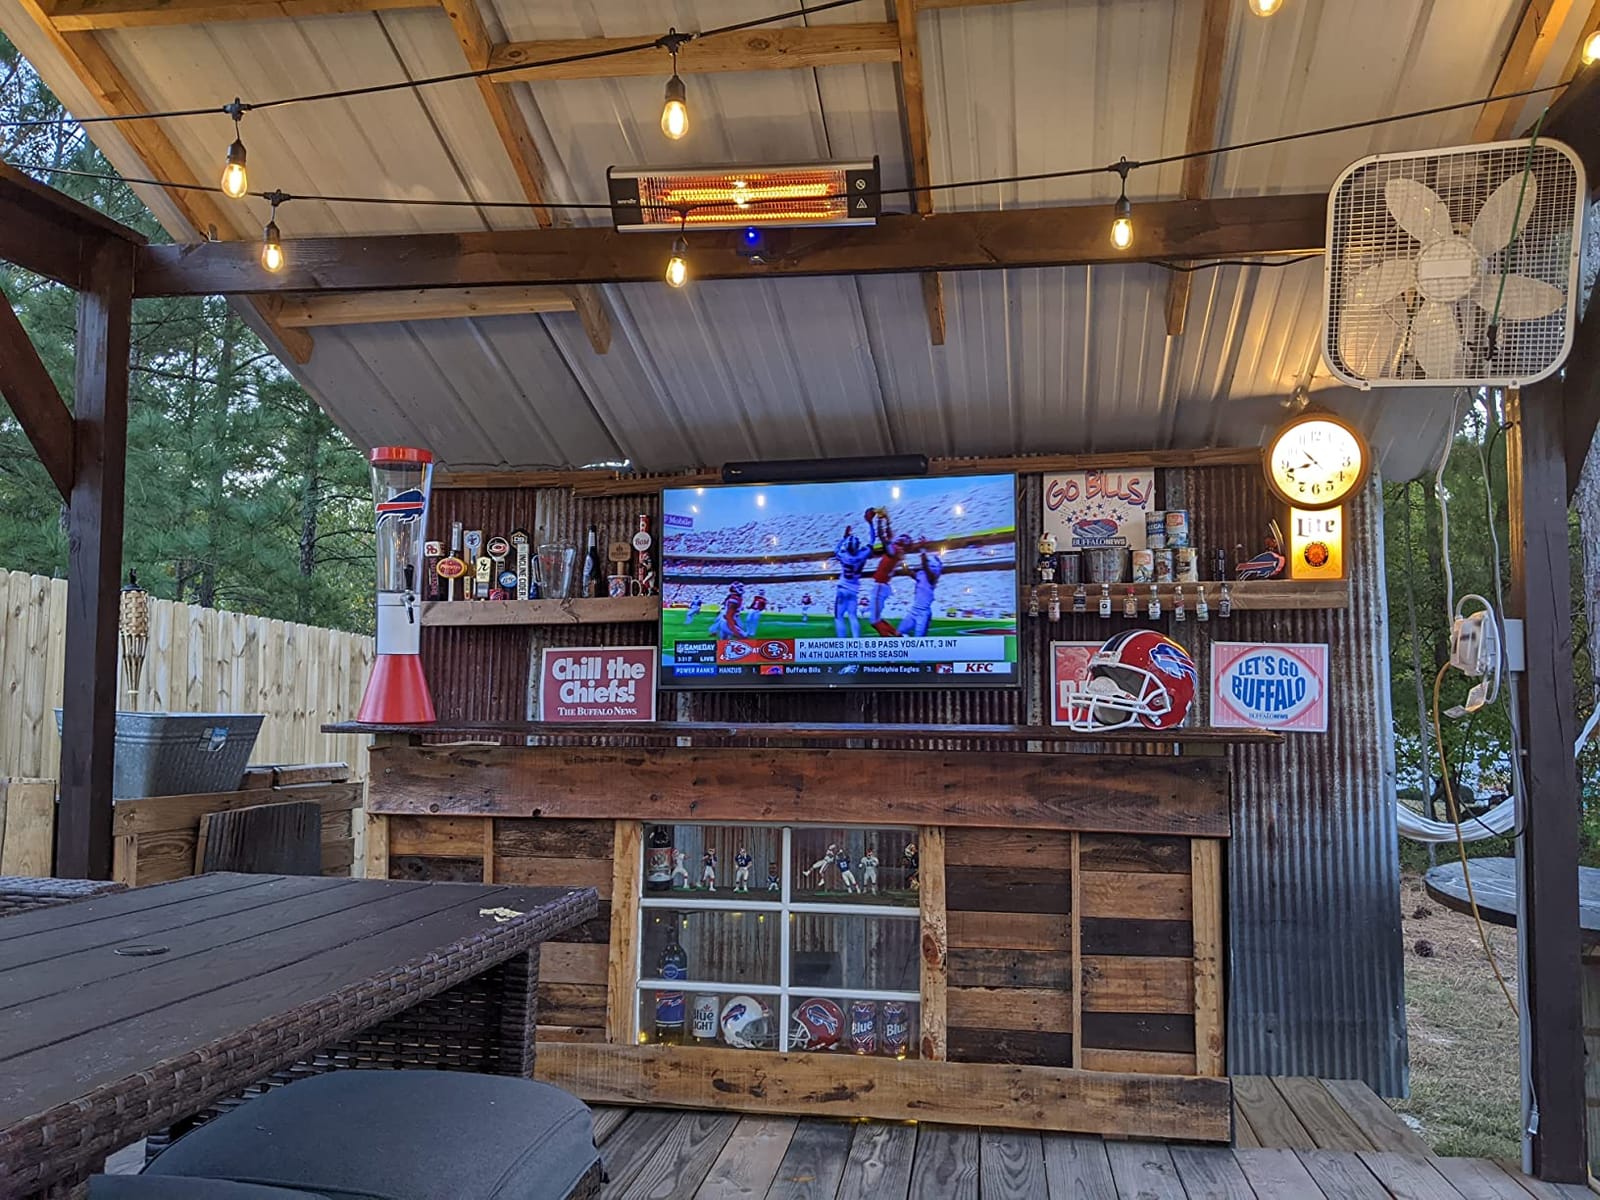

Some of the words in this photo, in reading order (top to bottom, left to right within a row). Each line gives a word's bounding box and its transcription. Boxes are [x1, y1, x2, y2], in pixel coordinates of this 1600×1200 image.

[1046, 479, 1080, 511] GO
[1085, 469, 1153, 510] BILLS!
[1311, 483, 1320, 495] 6
[684, 643, 715, 651] GAMEDAY
[808, 641, 844, 649] MAHOMES
[878, 640, 899, 648] PASS
[945, 640, 957, 648] INT
[800, 651, 807, 659] IN
[808, 651, 823, 659] 4TH
[825, 651, 858, 659] QUARTER
[860, 650, 876, 658] THIS
[878, 650, 909, 658] SEASON
[552, 657, 602, 680] Chill
[606, 656, 646, 679] the
[785, 666, 808, 674] Buffalo
[863, 666, 899, 674] Philadelphia
[899, 666, 920, 674] Eagles
[965, 662, 993, 673] KFC
[1238, 655, 1276, 676] LET'S
[1278, 657, 1299, 677] GO
[560, 679, 636, 704] Chiefs!
[1231, 674, 1306, 712] BUFFALO
[557, 706, 576, 716] THE
[576, 706, 614, 716] BUFFALO
[614, 706, 638, 716] NEWS
[694, 1021, 715, 1031] IGHT
[851, 1020, 873, 1035] Blue
